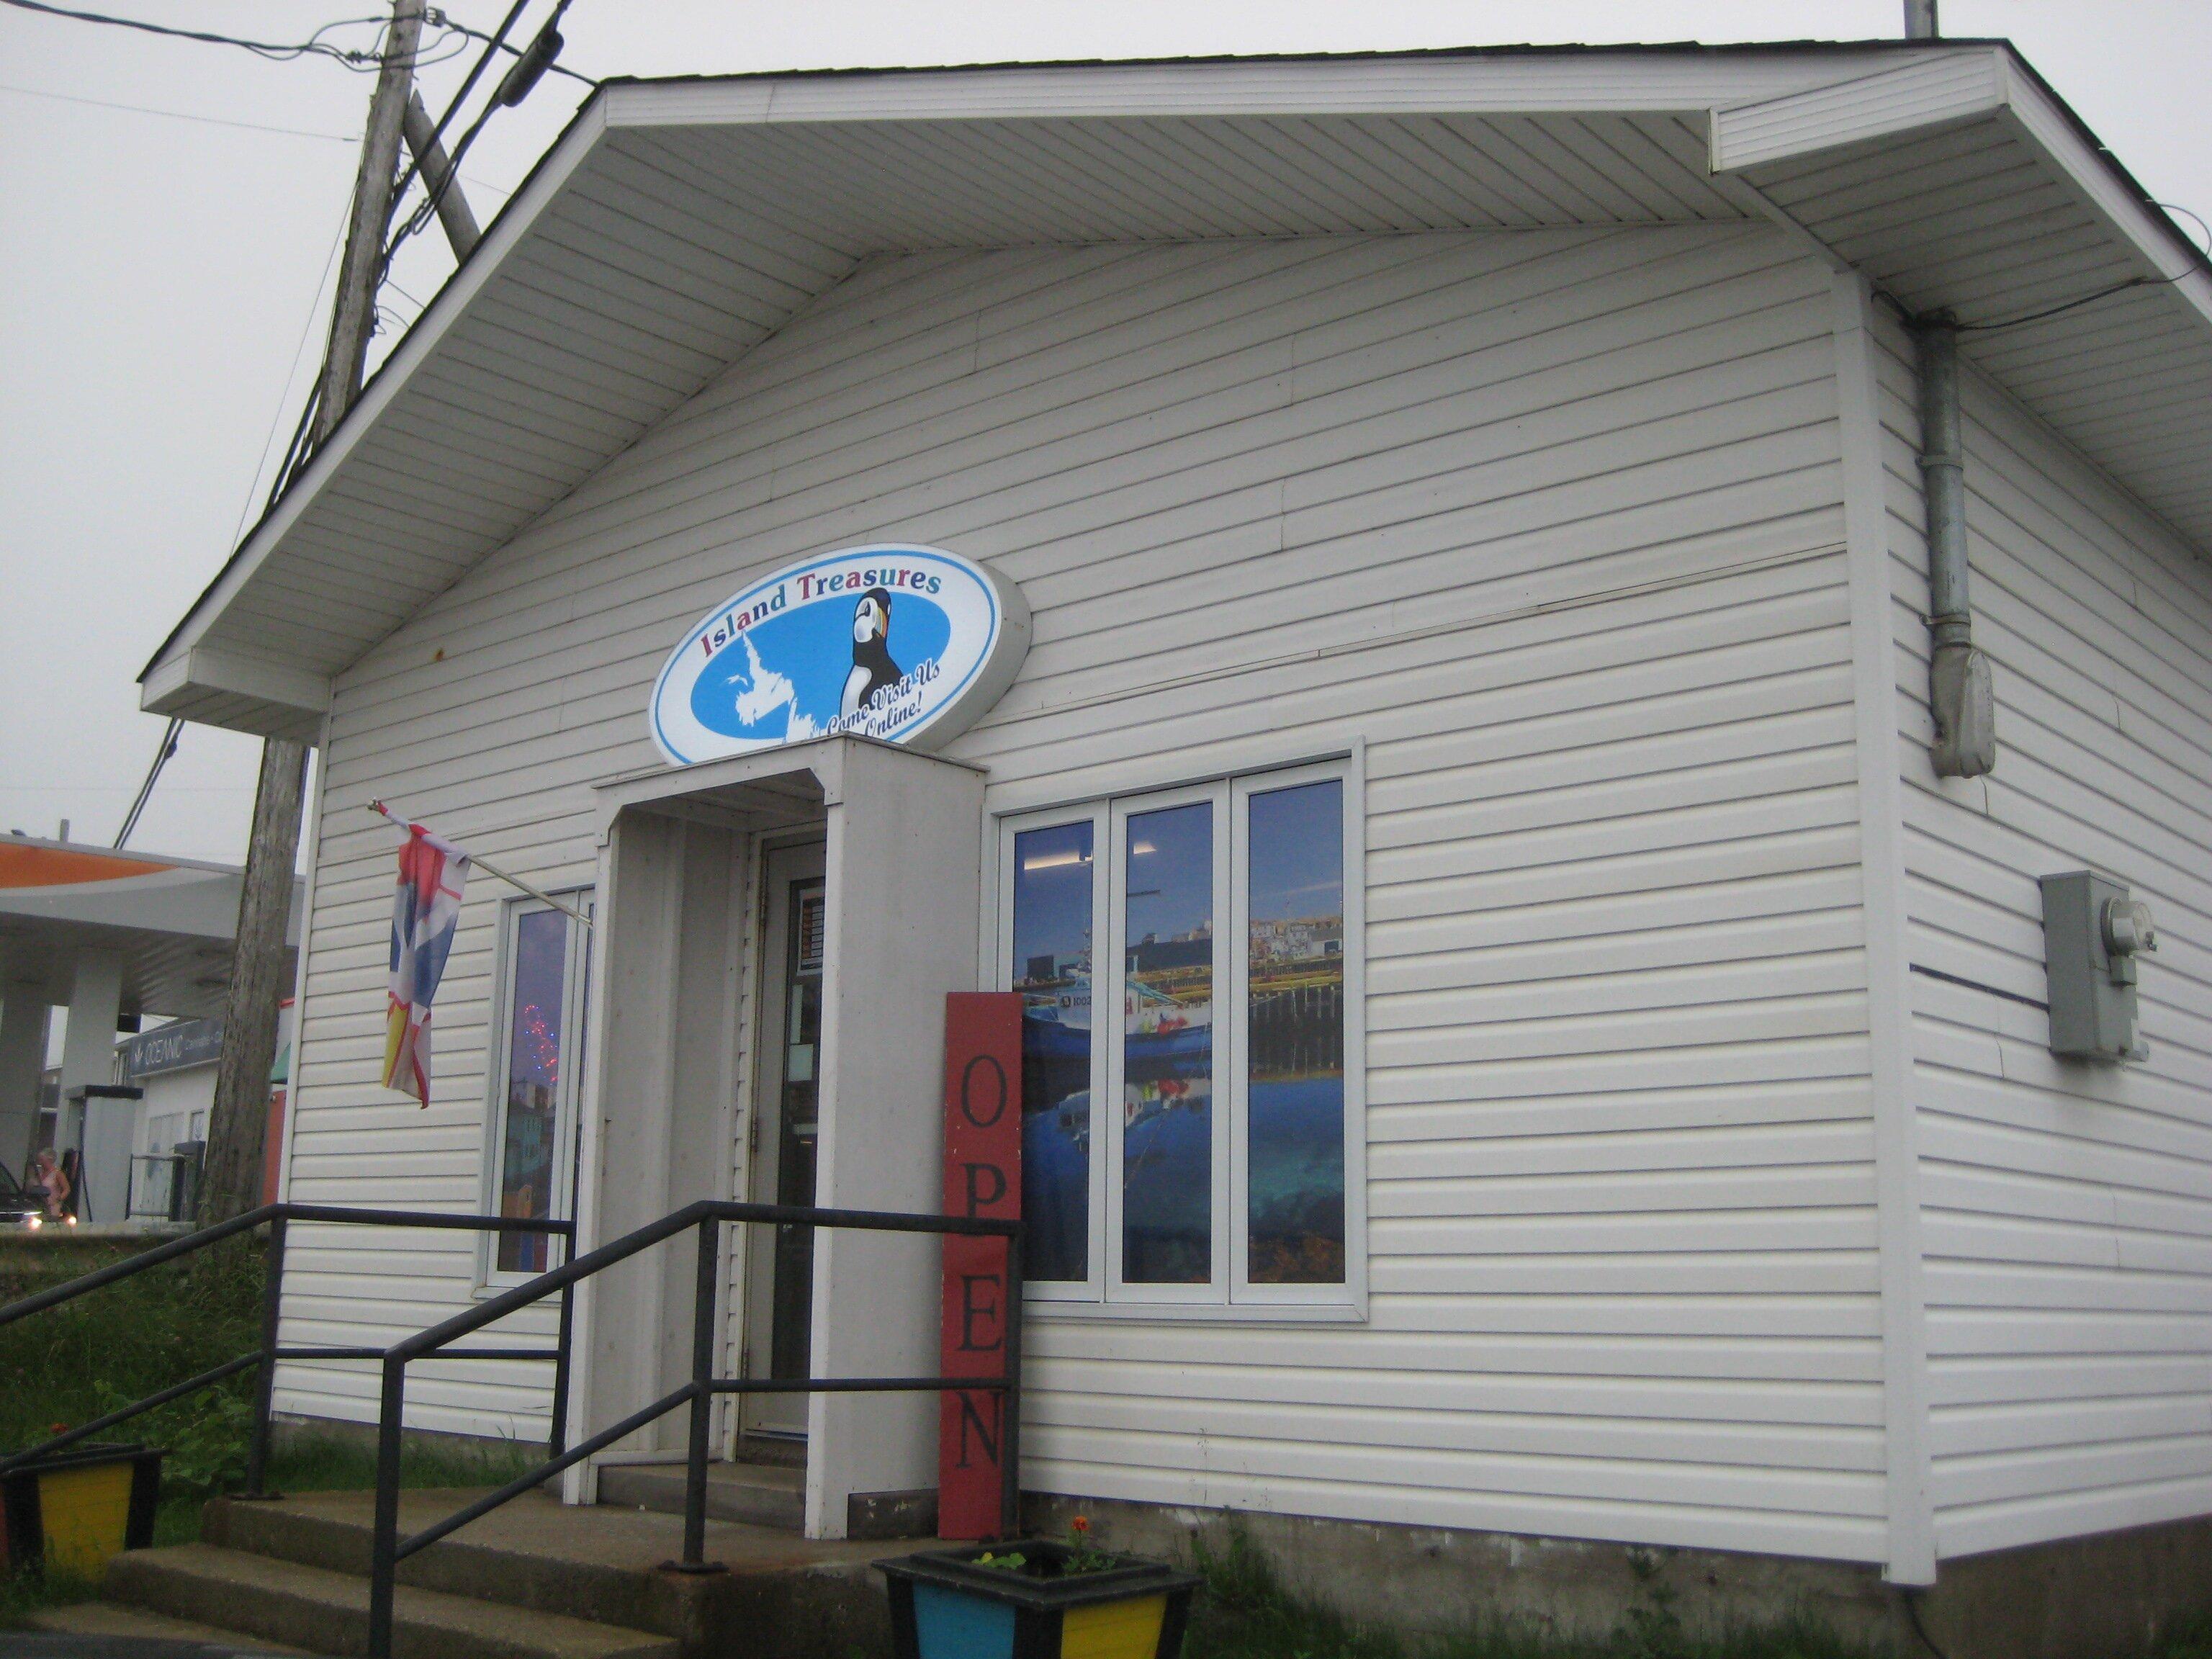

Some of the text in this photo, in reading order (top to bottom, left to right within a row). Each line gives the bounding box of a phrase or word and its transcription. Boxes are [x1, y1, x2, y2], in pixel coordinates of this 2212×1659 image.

[701, 568, 941, 657] Island Treasures
[827, 659, 940, 734] Come Visit Us
[865, 690, 922, 737] Online!
[956, 1054, 1007, 1468] OPEN
